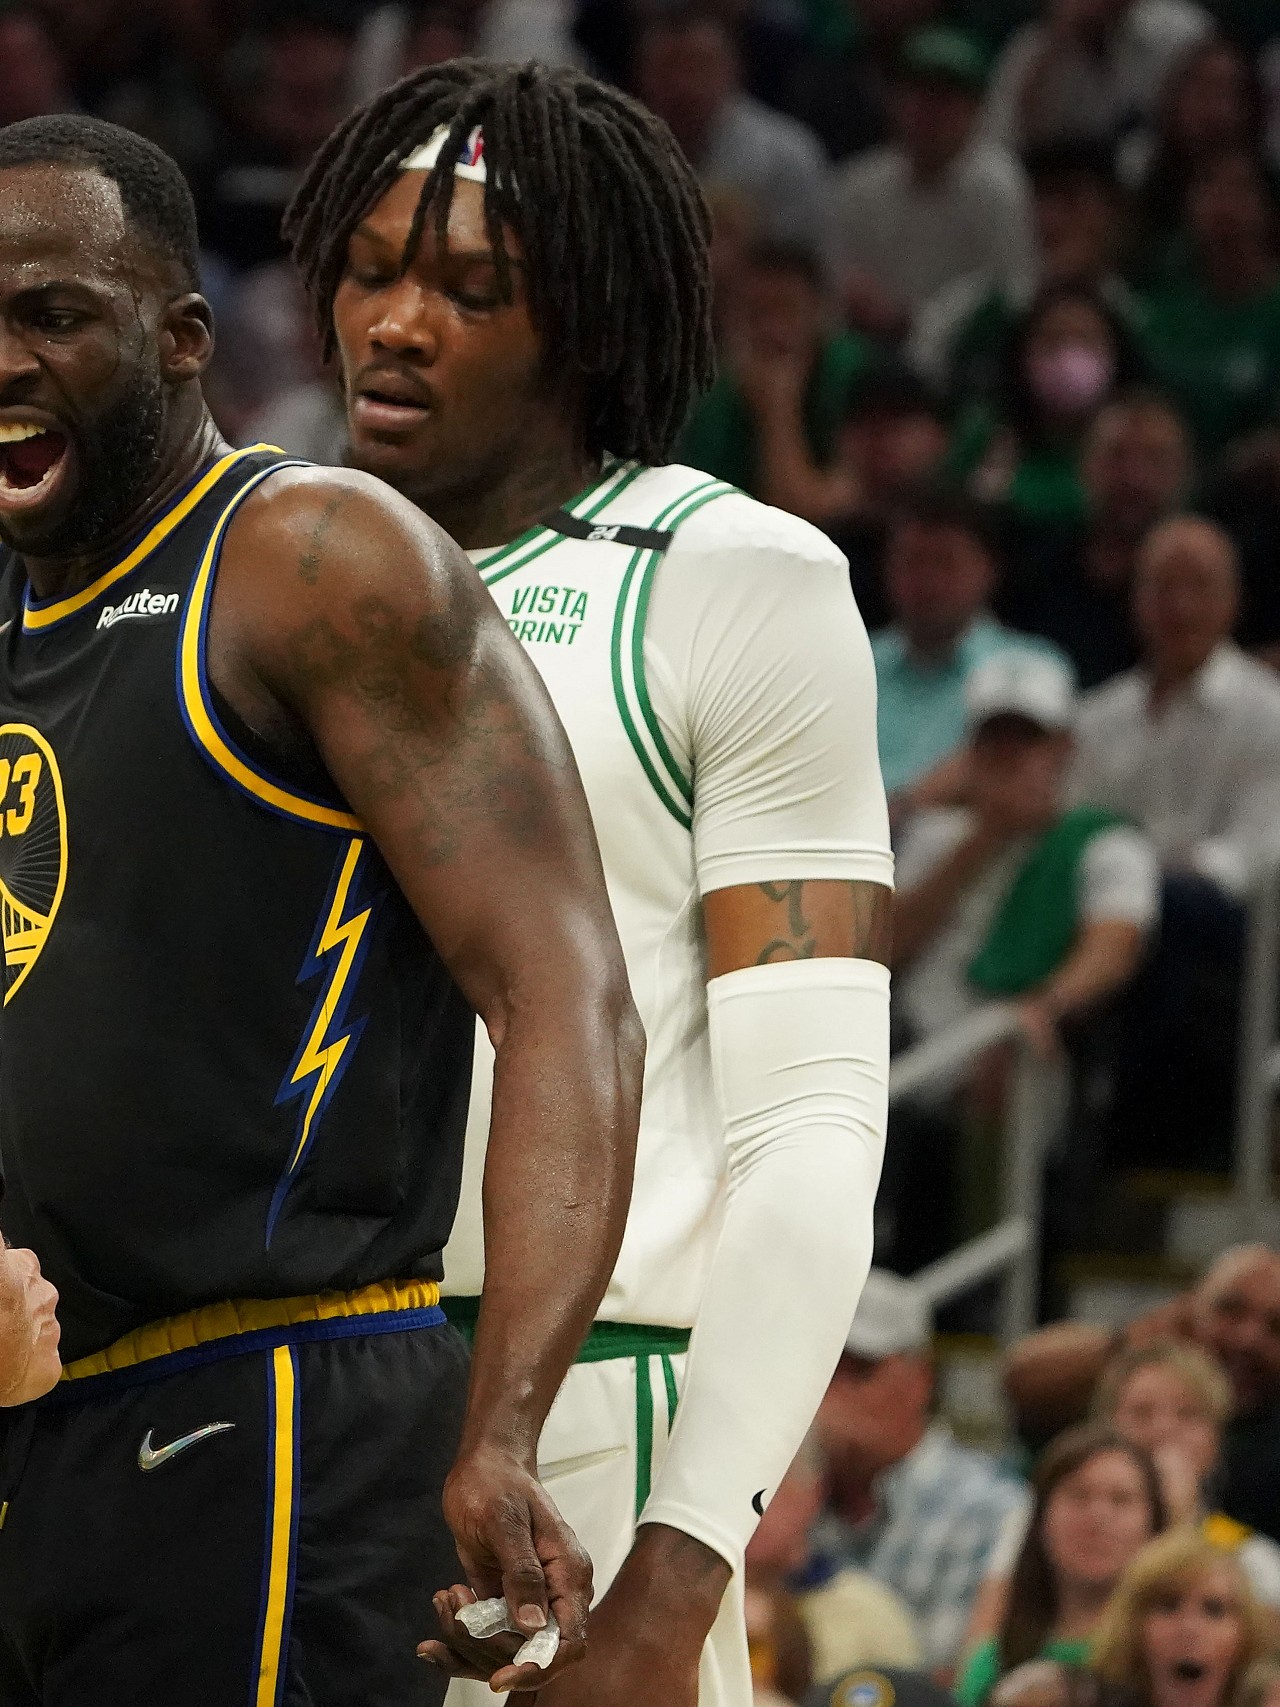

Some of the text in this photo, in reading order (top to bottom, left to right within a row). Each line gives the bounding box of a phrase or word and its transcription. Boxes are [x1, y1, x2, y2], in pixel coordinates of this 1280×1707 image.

[587, 526, 621, 540] 24
[96, 588, 179, 630] Rauten
[511, 586, 588, 621] VISTA
